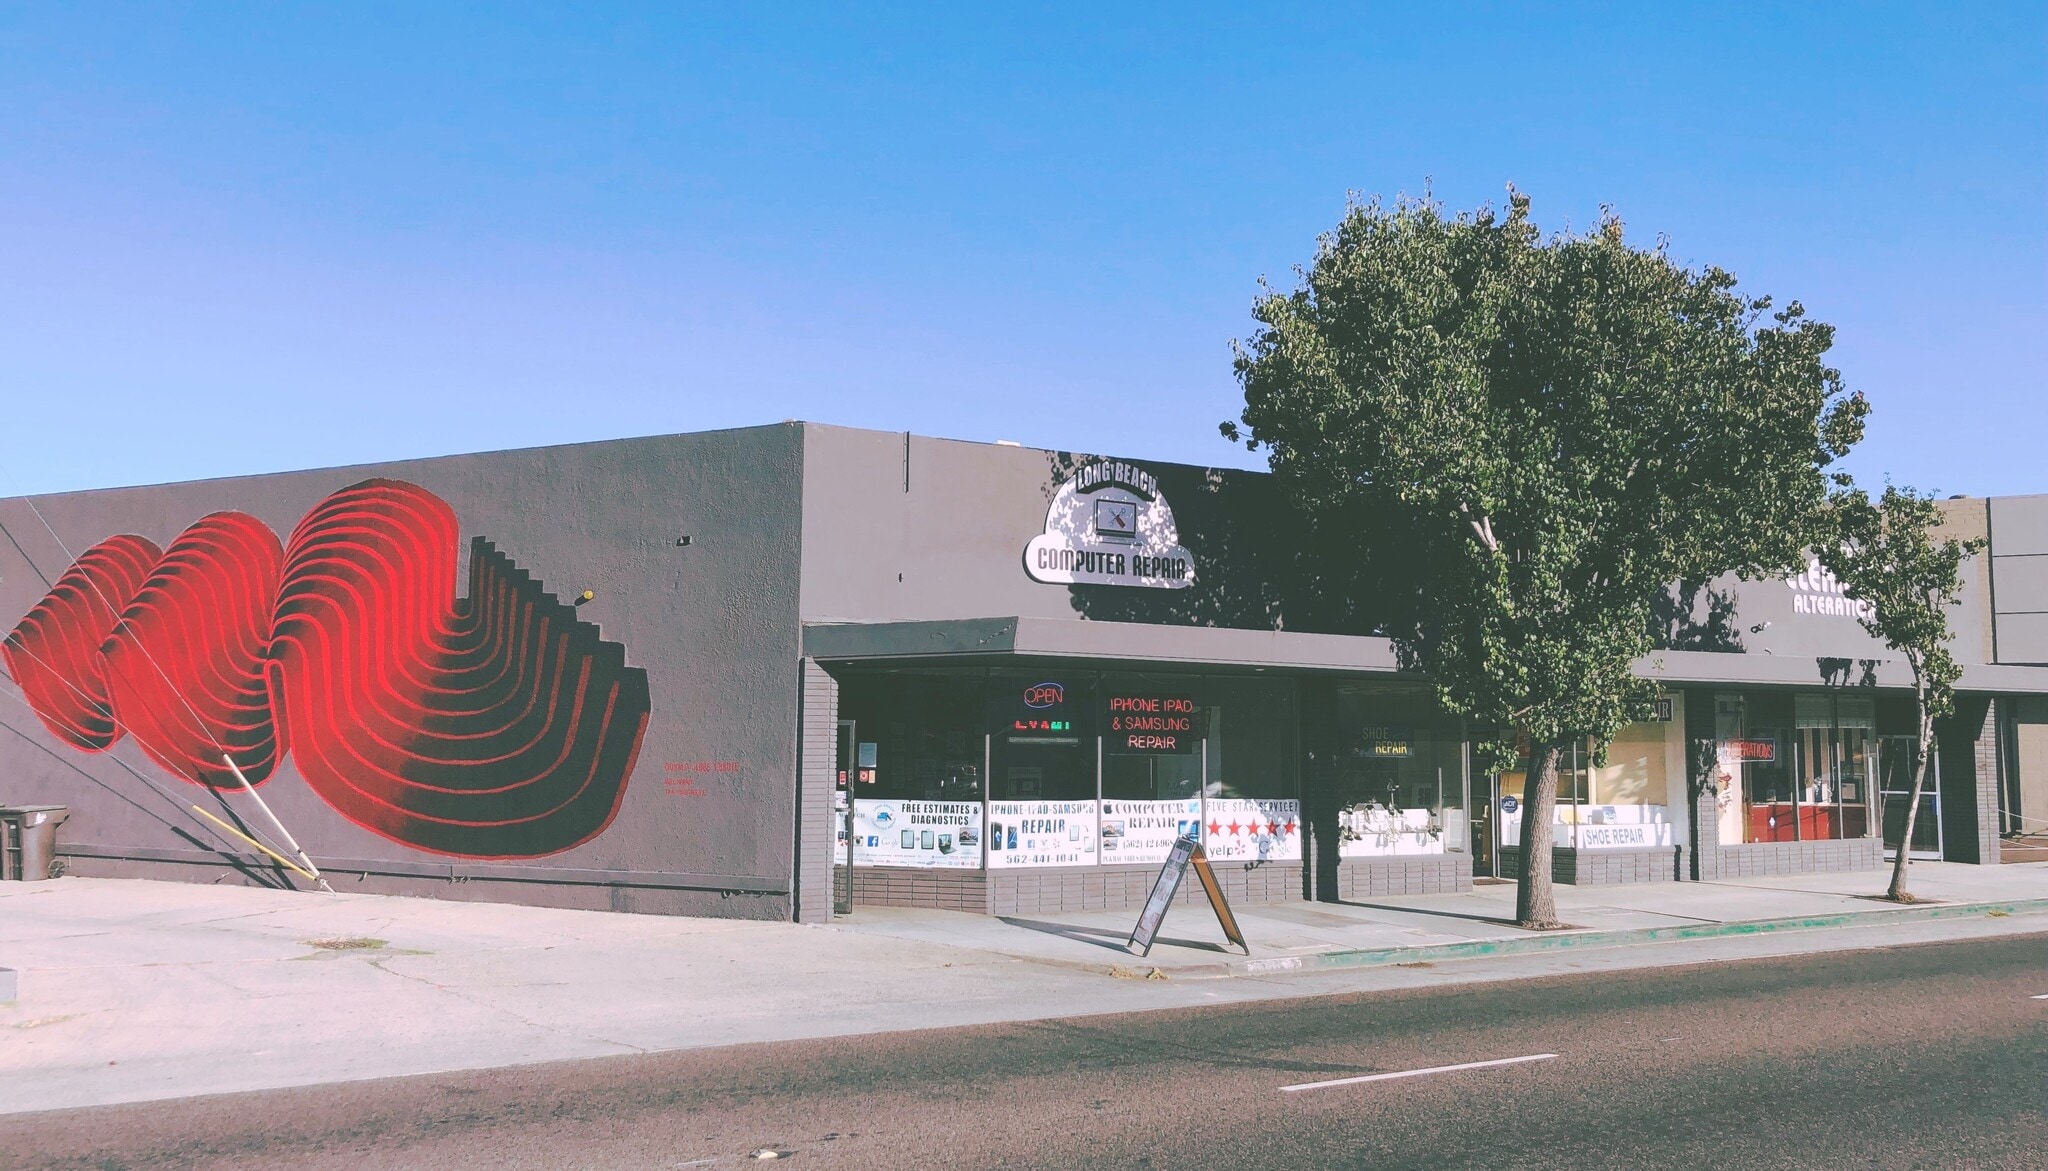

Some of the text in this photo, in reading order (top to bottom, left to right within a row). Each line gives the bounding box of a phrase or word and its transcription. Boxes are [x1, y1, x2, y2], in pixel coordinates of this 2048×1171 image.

[1077, 461, 1158, 499] LONG BEACH
[1038, 547, 1186, 579] COMPUTER REPAIR
[1024, 687, 1063, 704] OPEN
[1110, 698, 1193, 713] IPHONE IPAD
[1112, 716, 1190, 730] & SAMSUNG
[1362, 727, 1389, 740] SHOE
[1128, 734, 1176, 749] REPAIR
[1375, 740, 1408, 755] REPAIR
[902, 803, 979, 815] FREE ESTIMATES &
[1115, 802, 1185, 815] COMPUTER
[1206, 801, 1227, 812] FIVE
[911, 815, 970, 826] DIAGNOSTICS
[1022, 819, 1066, 834] REPAIR
[1129, 817, 1176, 829] REPAIR
[1586, 828, 1645, 845] SHOE REPAIR
[1209, 844, 1234, 857] yelp
